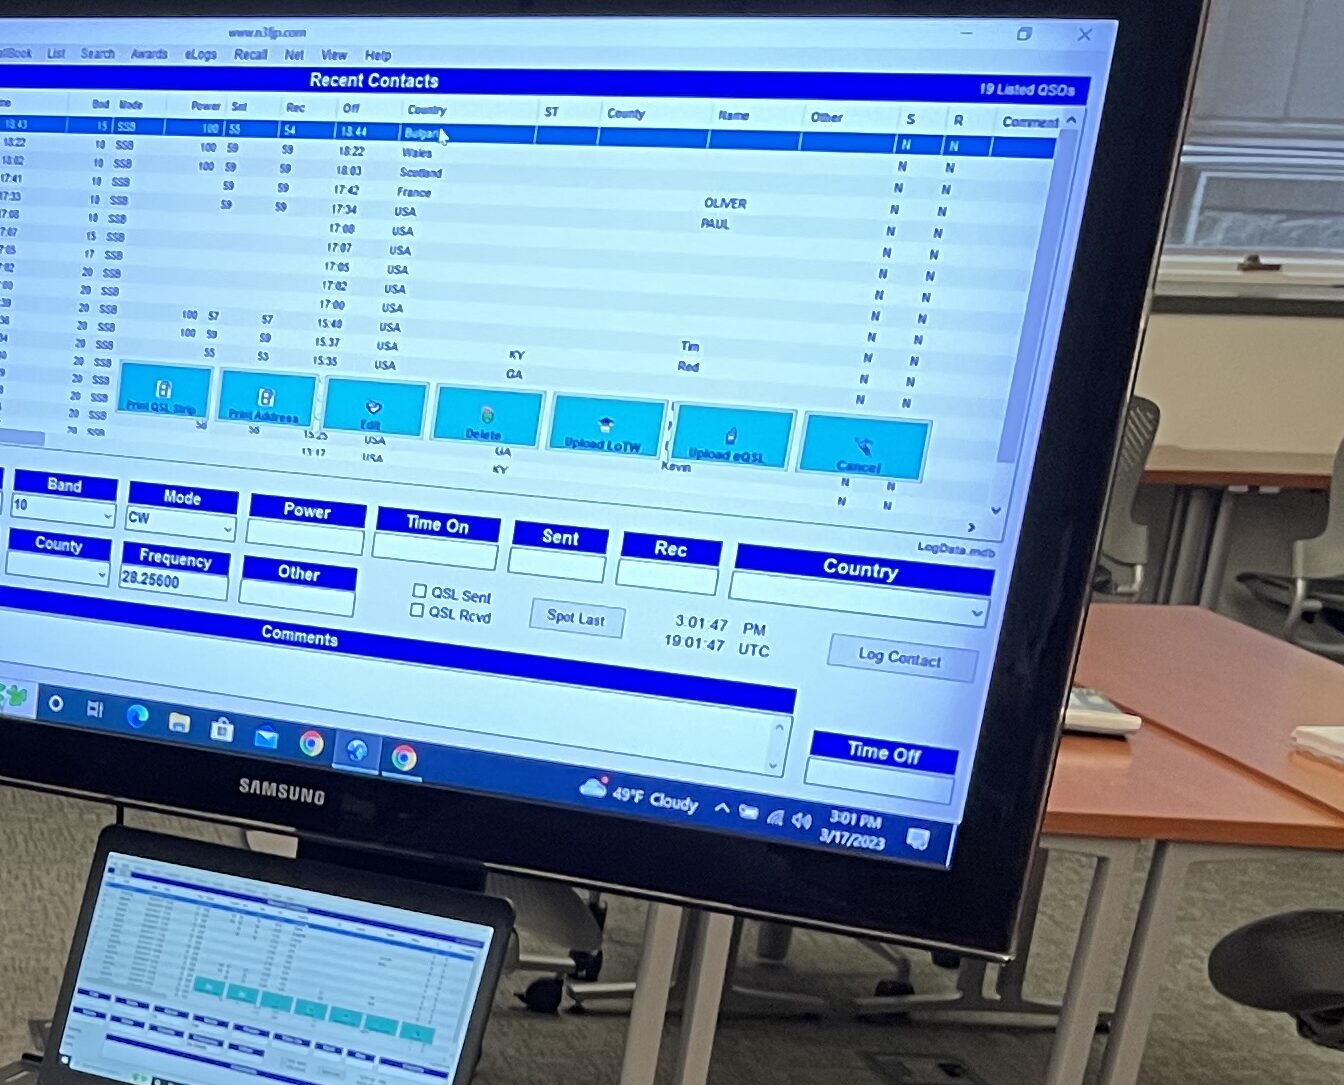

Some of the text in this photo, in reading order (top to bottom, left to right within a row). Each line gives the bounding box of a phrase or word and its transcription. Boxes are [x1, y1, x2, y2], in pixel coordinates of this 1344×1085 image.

[81, 49, 115, 60] Search
[234, 49, 267, 61] Recall
[322, 50, 347, 61] View
[365, 50, 392, 63] Help
[310, 72, 439, 89] Recent Contacts
[980, 83, 994, 95] 19
[997, 83, 1035, 96] Listed
[544, 106, 559, 117] ST
[395, 206, 416, 217] USA
[701, 218, 730, 230] PAUL
[48, 478, 82, 493] Band
[14, 499, 27, 511] 10
[164, 490, 201, 505] Mode
[129, 512, 149, 524] CW
[284, 503, 331, 519] Power
[407, 515, 469, 534] Time On
[36, 536, 82, 555] County
[543, 529, 579, 546] Sent
[655, 541, 687, 557] Rec
[140, 548, 212, 571] Frequency
[278, 564, 320, 581] Other
[824, 558, 898, 581] Country
[122, 569, 179, 589] 28.25600
[432, 586, 491, 604] QSL Sent
[429, 606, 491, 624] QSL Rcvd
[547, 609, 605, 627] Spot Last
[262, 625, 338, 647] Comments
[744, 623, 766, 636] PM
[739, 642, 770, 657] UTC
[859, 648, 941, 668] Log Contact
[848, 741, 921, 765] Time Off
[239, 778, 325, 806] SAMSUNG
[650, 791, 698, 815] Cloudy
[830, 810, 882, 829] 3:01 PM
[820, 828, 886, 851] 3/17/2023
